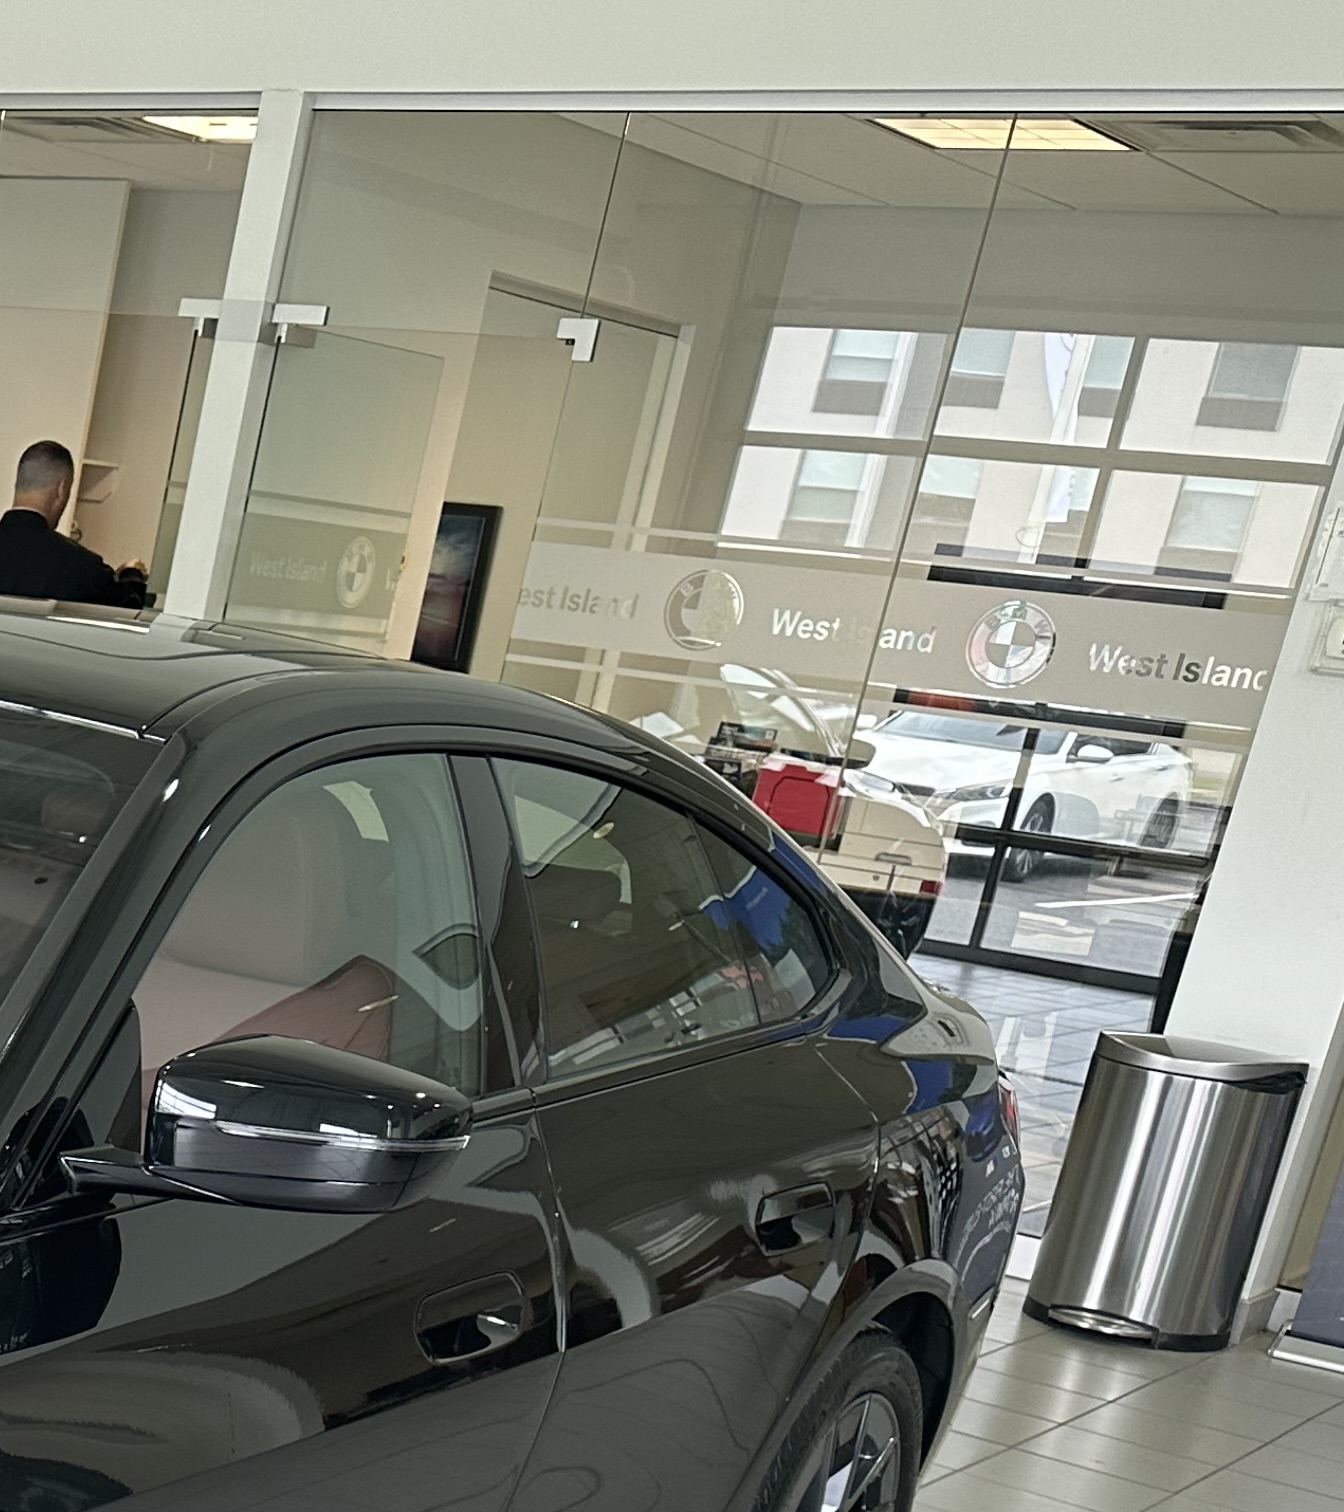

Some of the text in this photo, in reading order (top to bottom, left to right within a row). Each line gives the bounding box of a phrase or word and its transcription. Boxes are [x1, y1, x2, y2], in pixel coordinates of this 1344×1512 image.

[518, 585, 557, 610] est
[771, 607, 841, 641] West
[1089, 642, 1169, 679] West
